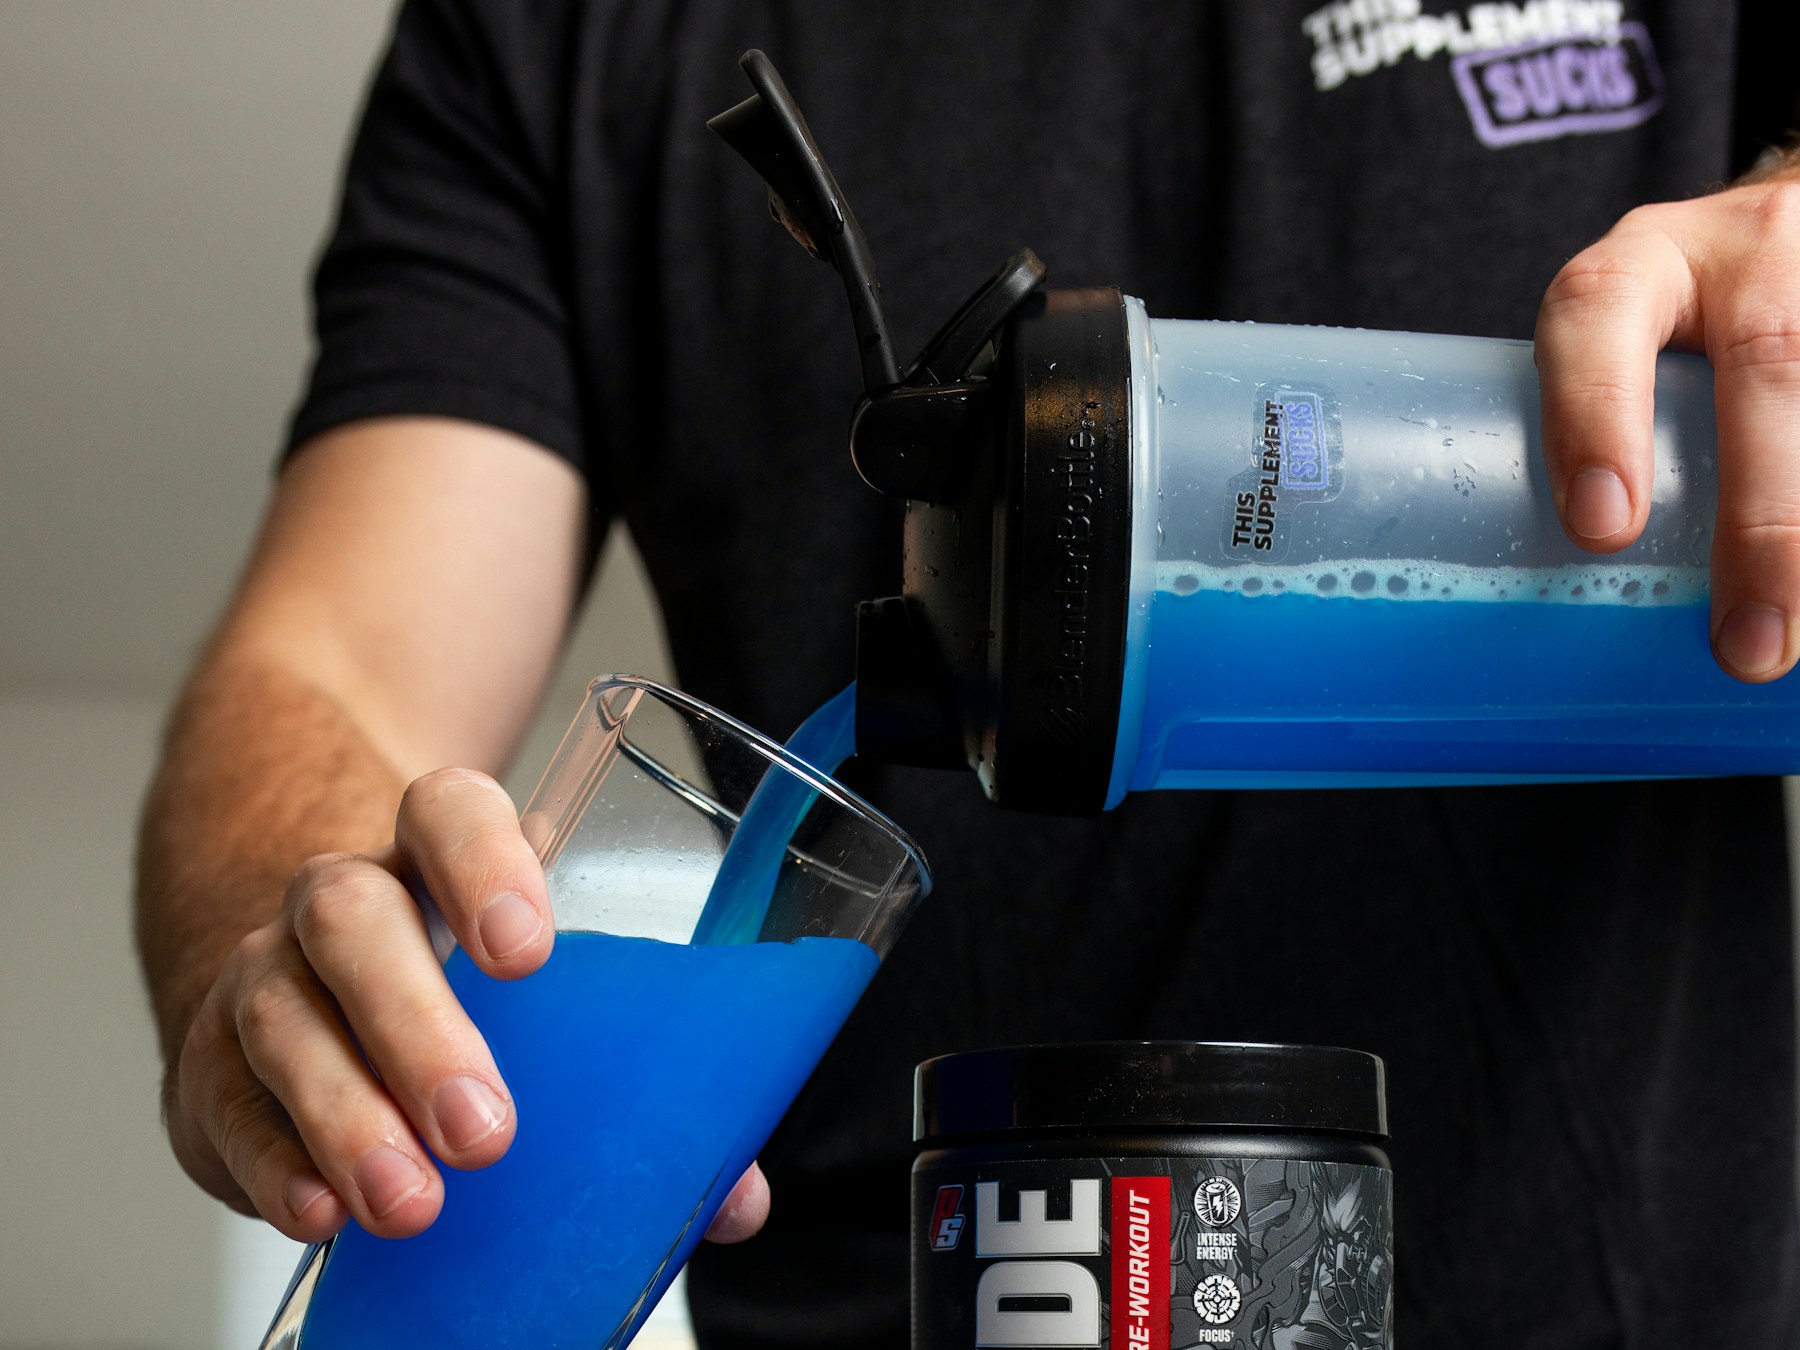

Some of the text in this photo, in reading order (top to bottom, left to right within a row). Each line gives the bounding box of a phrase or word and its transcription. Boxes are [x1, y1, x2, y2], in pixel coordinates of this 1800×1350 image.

[1302, 0, 1422, 45] THIS
[1311, 0, 1623, 91] SUPPLEMENT
[1483, 44, 1637, 121] SUCKS
[1253, 399, 1284, 551] SUPPLEMENT
[1285, 401, 1319, 479] SUCKS
[1232, 491, 1256, 548] THIS
[1197, 1233, 1238, 1246] INTENSE
